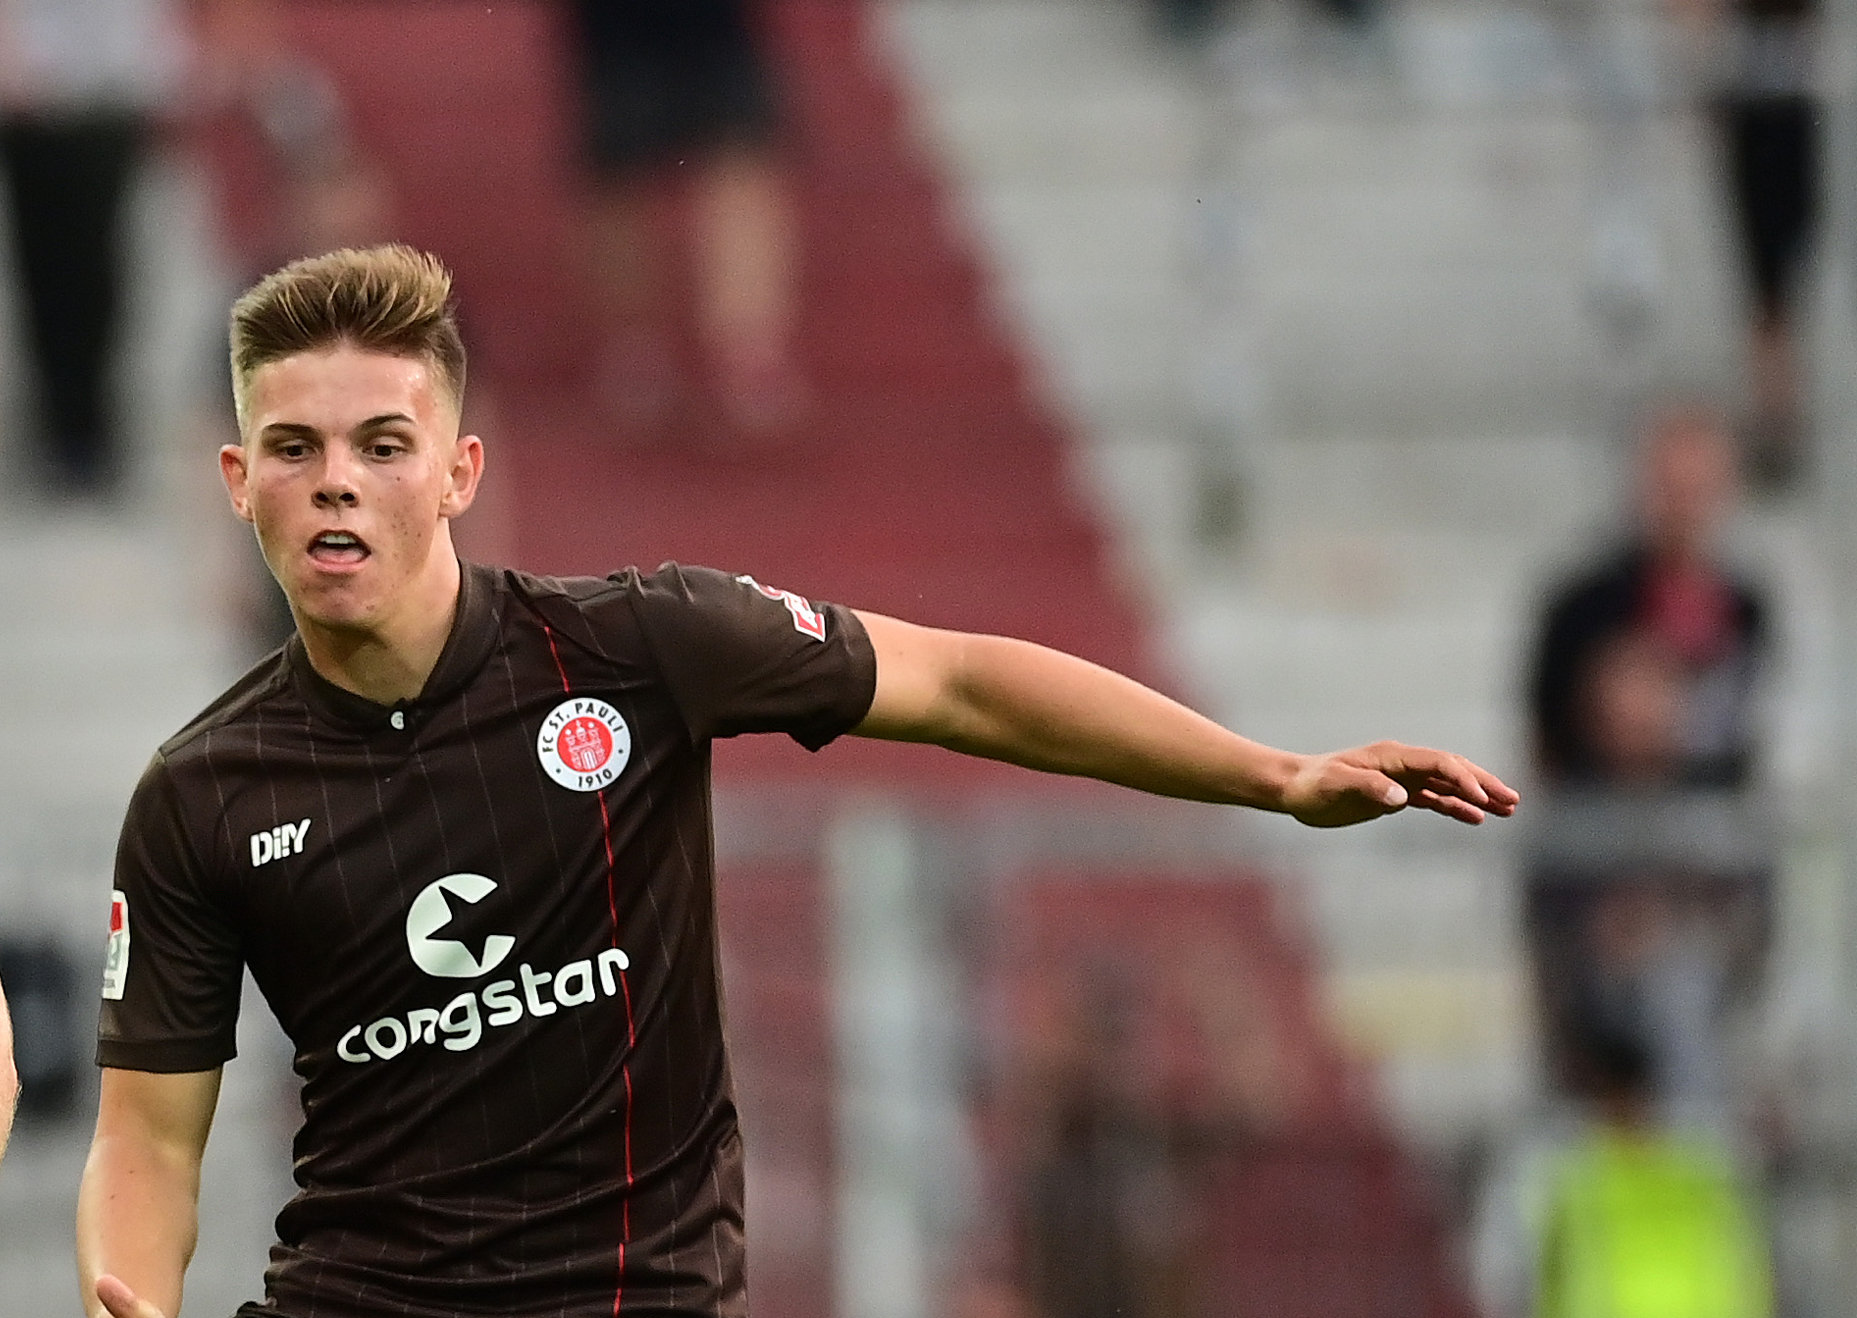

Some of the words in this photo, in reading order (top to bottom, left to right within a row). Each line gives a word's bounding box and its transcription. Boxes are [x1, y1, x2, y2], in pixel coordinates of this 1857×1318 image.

[542, 736, 554, 753] FC
[549, 711, 571, 730] ST.
[575, 702, 624, 732] PAULI
[578, 768, 613, 788] 1910
[336, 948, 630, 1063] congstar
